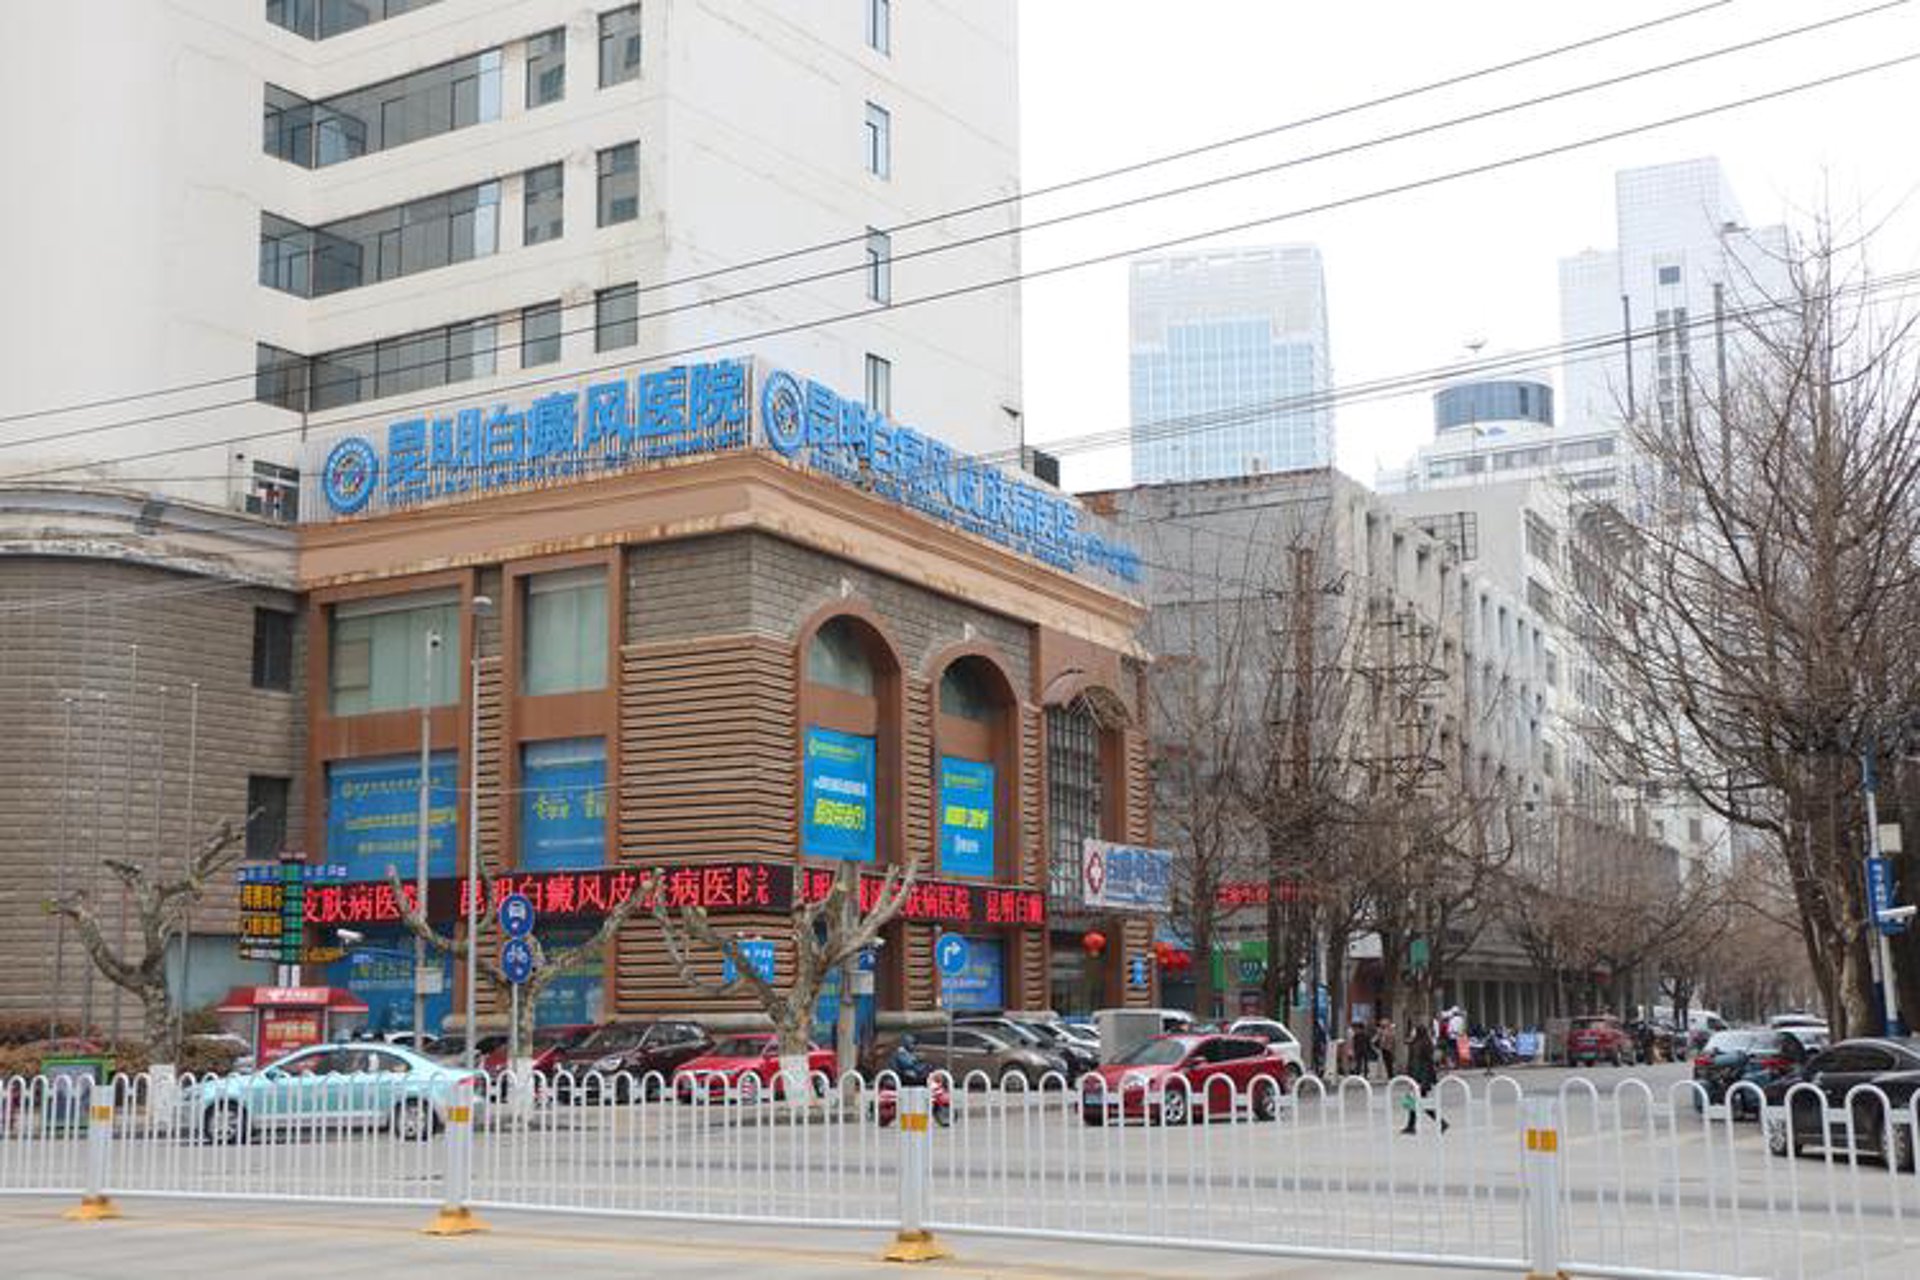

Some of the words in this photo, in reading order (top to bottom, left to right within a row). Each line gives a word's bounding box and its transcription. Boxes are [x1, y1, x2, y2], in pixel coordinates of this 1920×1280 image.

[385, 358, 747, 487] 昆明白癜风医院
